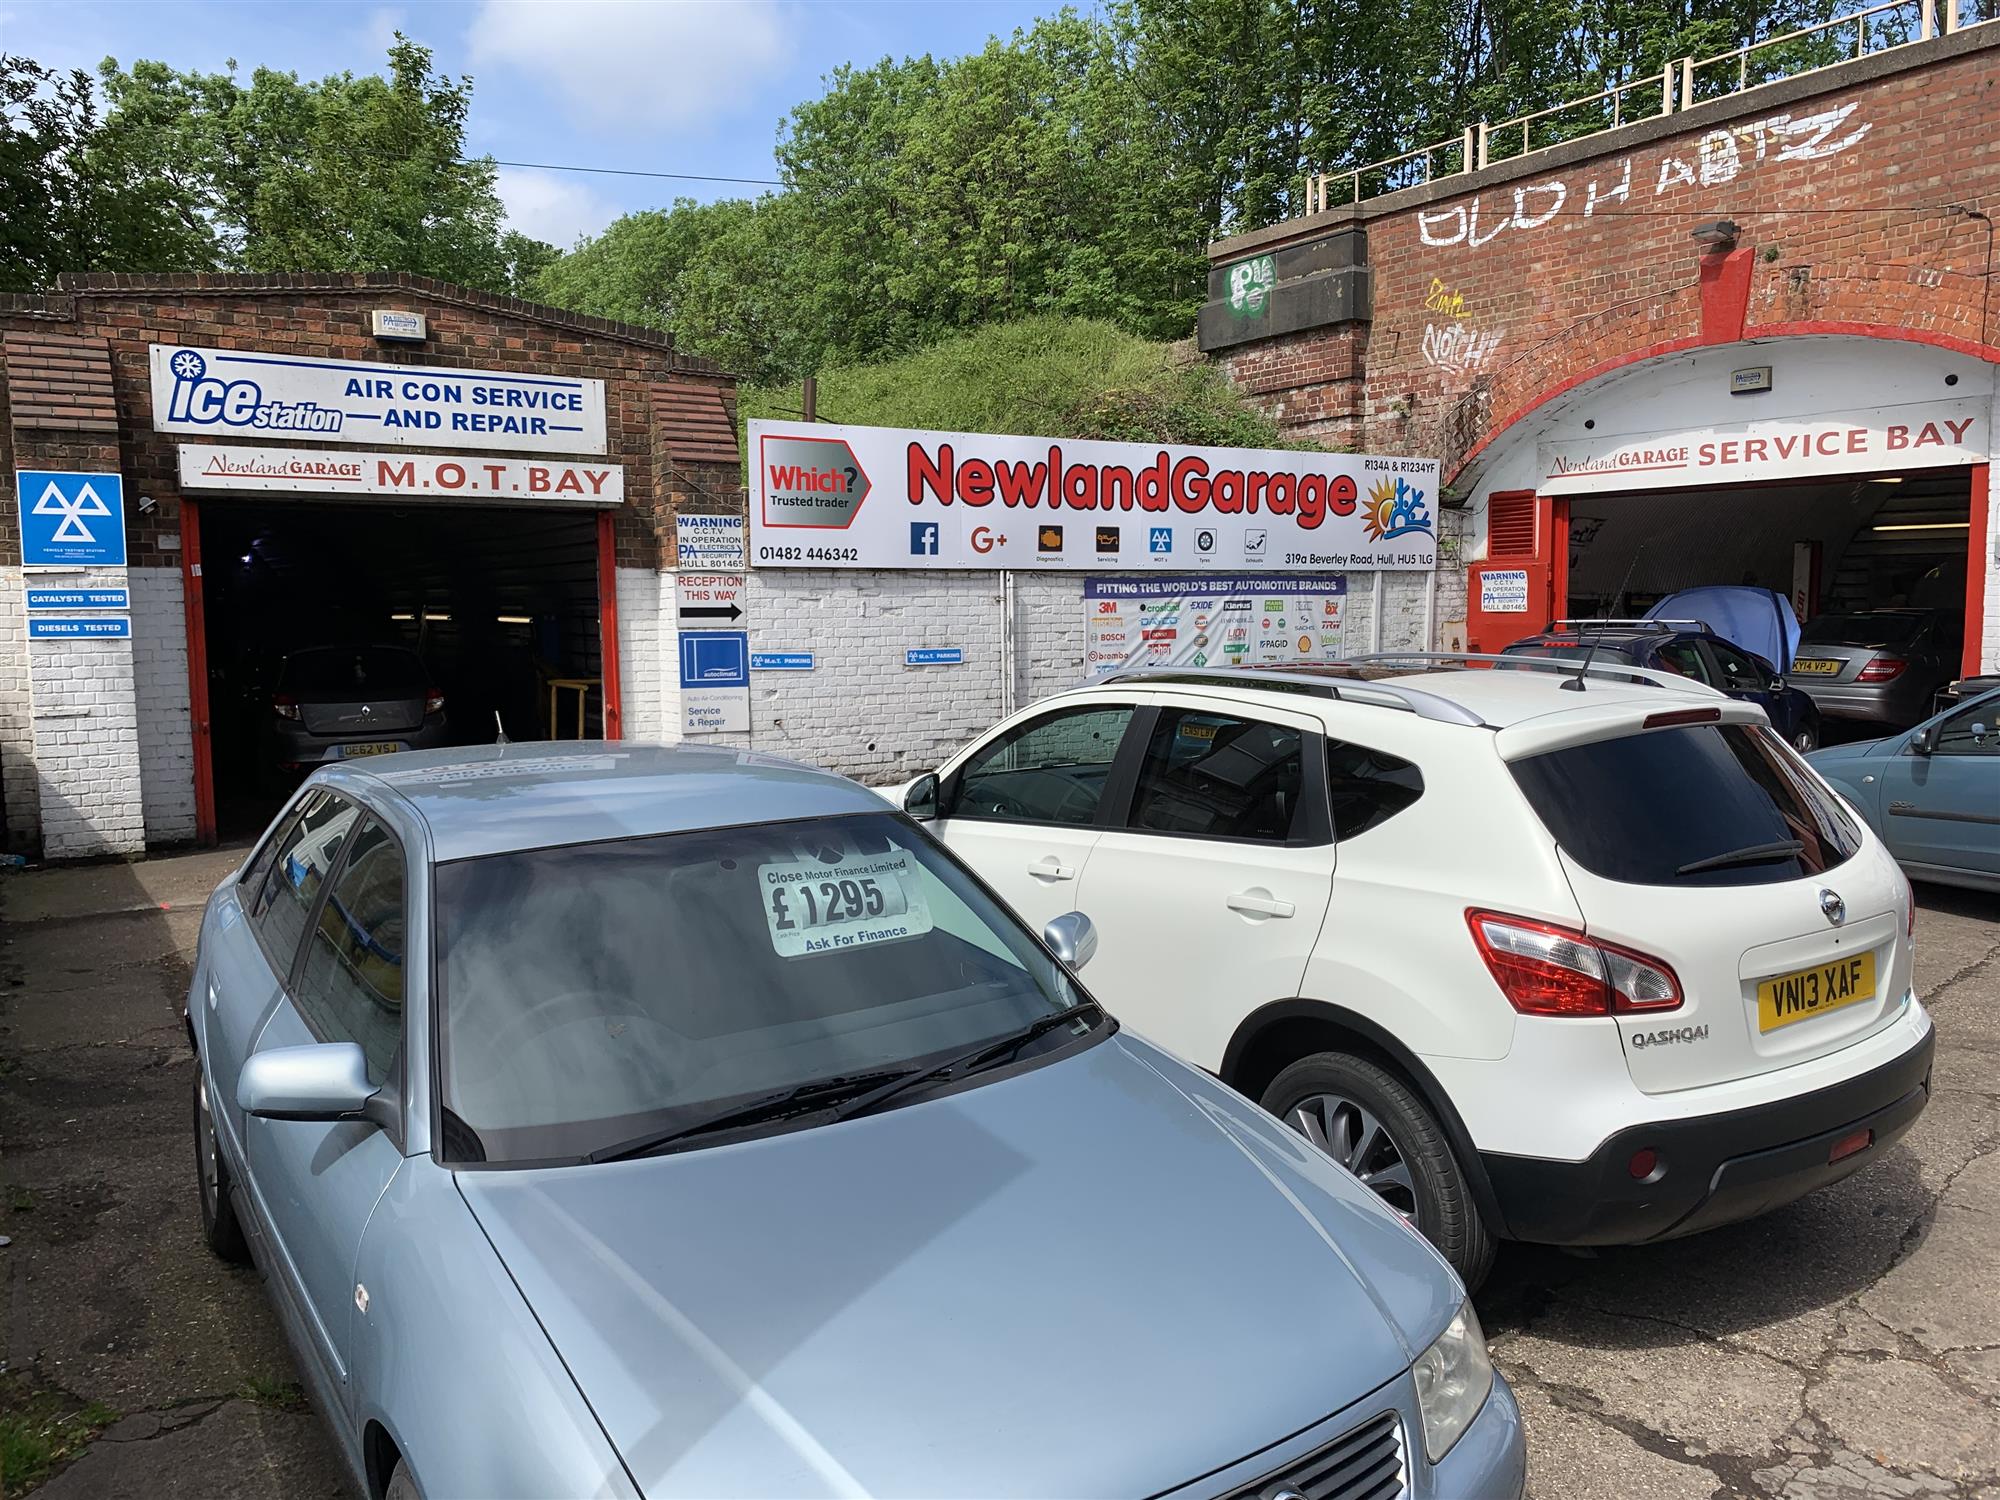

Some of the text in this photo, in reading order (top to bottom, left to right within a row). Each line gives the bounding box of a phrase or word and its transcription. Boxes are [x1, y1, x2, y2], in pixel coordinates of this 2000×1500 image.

[168, 353, 342, 432] ice station
[345, 379, 583, 411] AIR CON SERVICE
[383, 409, 548, 435] AND REPAIR
[1698, 428, 1869, 466] SERVICE
[1886, 417, 1975, 451] BAY
[1364, 459, 1436, 473] R134A & R1234YF
[529, 467, 611, 495] BAY
[769, 465, 858, 493] Which?
[770, 495, 849, 508] Trusted trader
[677, 517, 742, 528] WARNING
[693, 527, 725, 535] C.C.T.V.
[691, 536, 741, 544] OPERATION
[678, 544, 698, 559] PA
[760, 547, 858, 561] 01482 446342
[680, 560, 744, 568] HULL 801465
[1285, 553, 1433, 566] 319a Beverley Road, Hull, HU5 1LG
[678, 576, 743, 587] RECEPTION
[1481, 572, 1525, 580] WARNING
[1096, 580, 1337, 594] FITTING THE WORLD'S BEST AUTOMOTIVE BRANDS
[684, 590, 737, 600] THIS WAY
[1483, 593, 1495, 604] PA
[1098, 601, 1117, 614] 3M
[1190, 600, 1214, 610] EXIDE
[37, 624, 79, 632] DIESELS
[1100, 633, 1126, 641] BOSCH
[1266, 639, 1288, 648] PAGID
[1098, 651, 1129, 660] brembo
[1792, 661, 1833, 671] KY14 VPJ
[687, 707, 721, 716] Service
[688, 717, 726, 728] & Repair
[376, 743, 397, 753] VSJ
[767, 858, 906, 884] Close Motor Finance Limited
[805, 926, 908, 951] Ask For Finance
[1772, 959, 1863, 1018] VN13 XAF
[1631, 1023, 1710, 1050] QASHQAI
